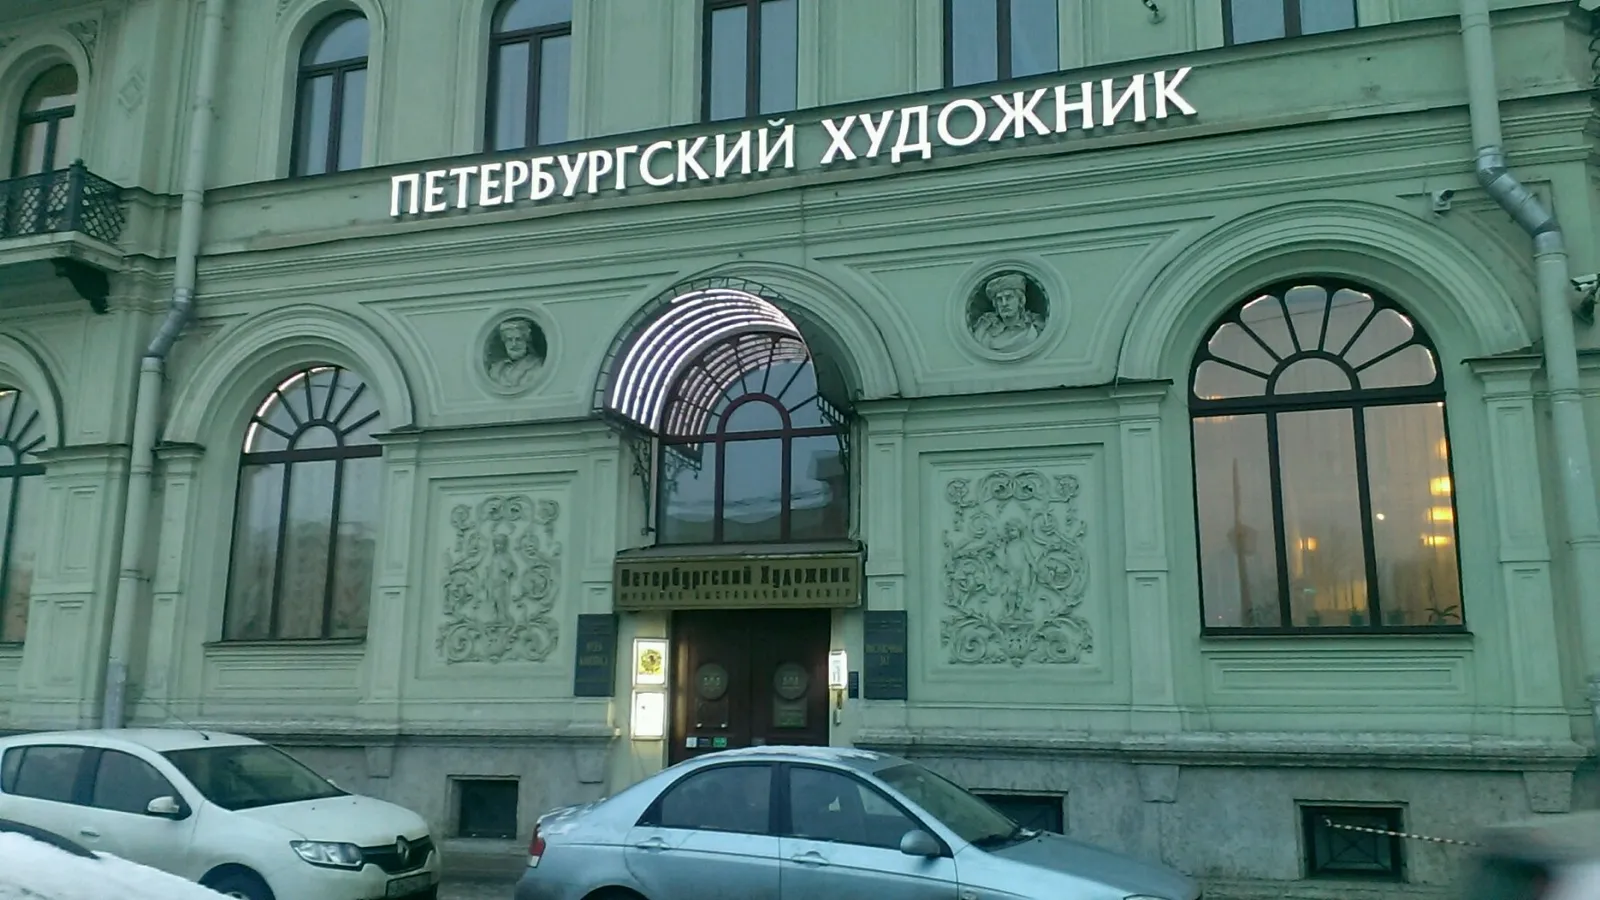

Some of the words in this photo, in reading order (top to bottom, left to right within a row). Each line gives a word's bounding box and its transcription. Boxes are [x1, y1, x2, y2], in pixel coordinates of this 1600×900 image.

[389, 118, 796, 218] ПЕТЕРБУРГСКИЙ
[820, 66, 1198, 164] ХУДОЖНИК
[620, 565, 752, 590] Петербургский
[760, 565, 850, 588] Художник
